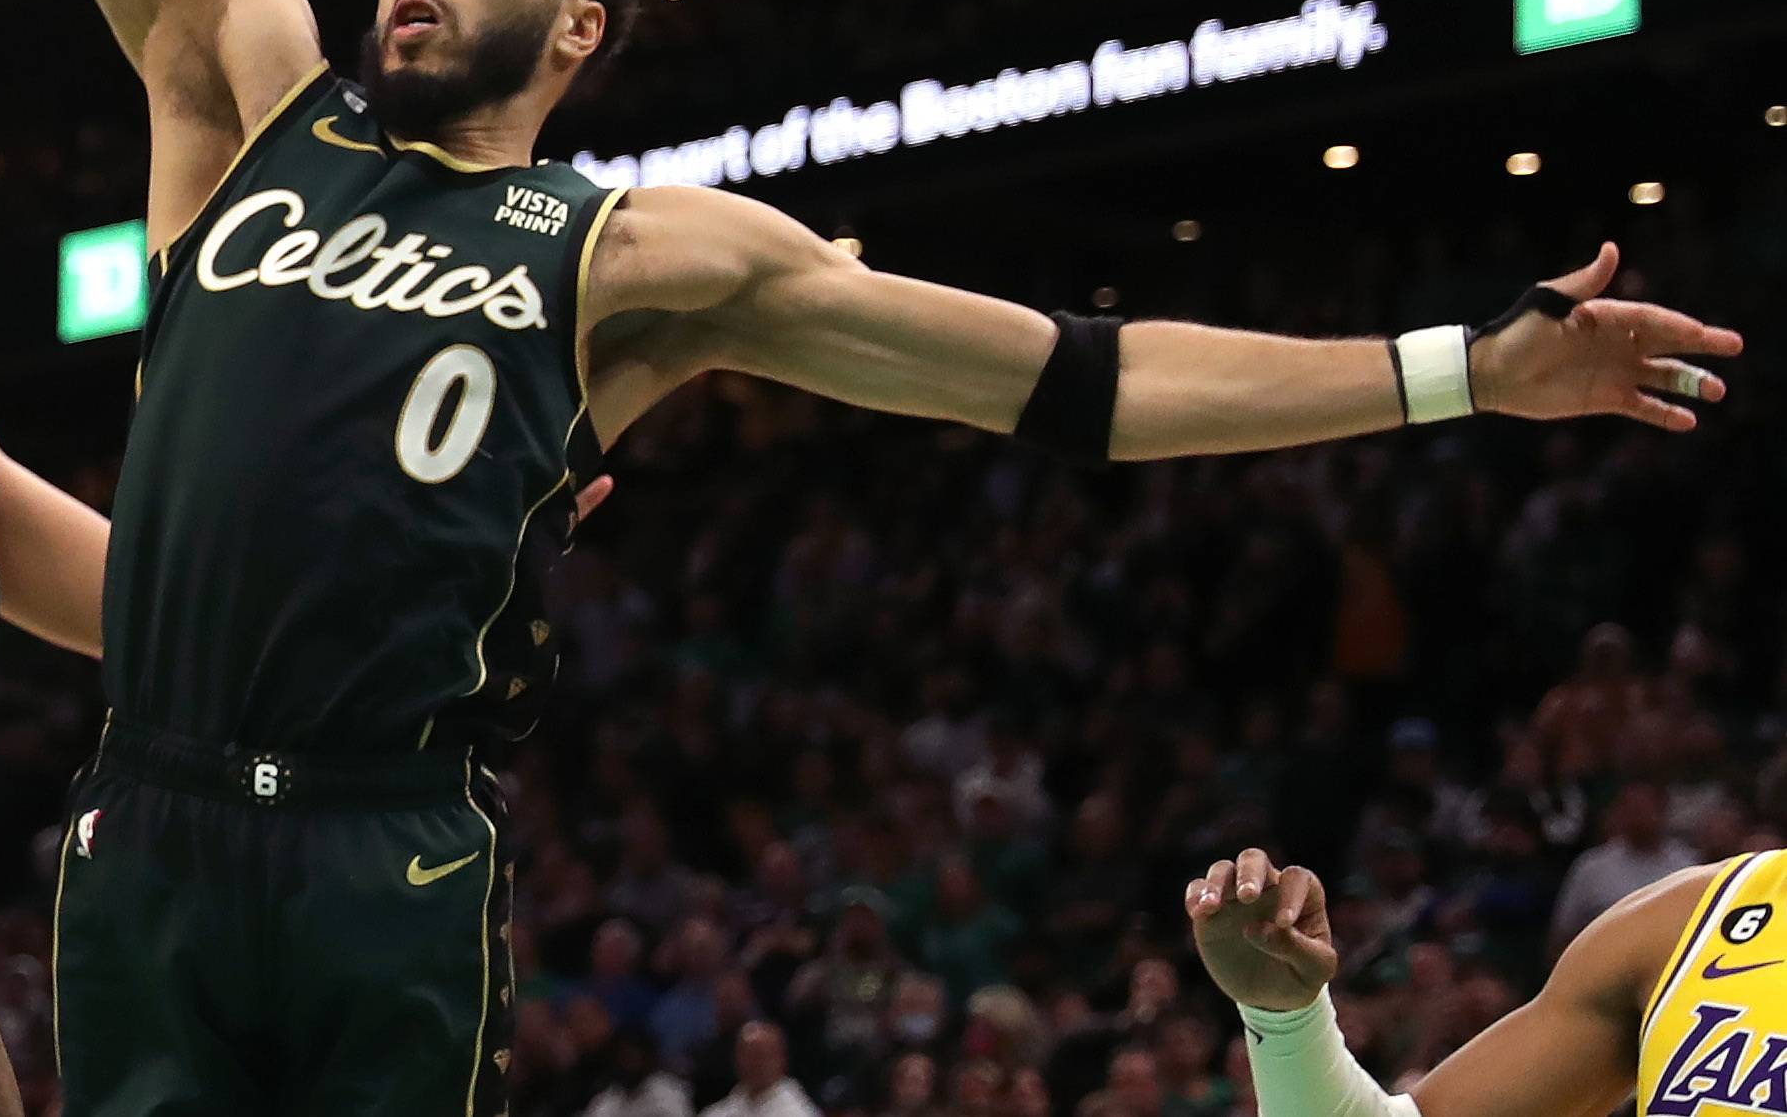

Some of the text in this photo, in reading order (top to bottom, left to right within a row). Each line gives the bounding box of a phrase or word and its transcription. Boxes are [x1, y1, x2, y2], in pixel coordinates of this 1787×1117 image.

[640, 125, 751, 188] part
[750, 105, 810, 177] of
[810, 96, 900, 165] the
[900, 59, 1091, 146] Boston
[1091, 39, 1189, 107] fan
[494, 204, 566, 236] PRINT
[506, 185, 569, 224] VISTA
[196, 189, 547, 330] Celtics
[394, 344, 497, 484] 0
[253, 763, 279, 797] 6
[1729, 908, 1766, 940] 6
